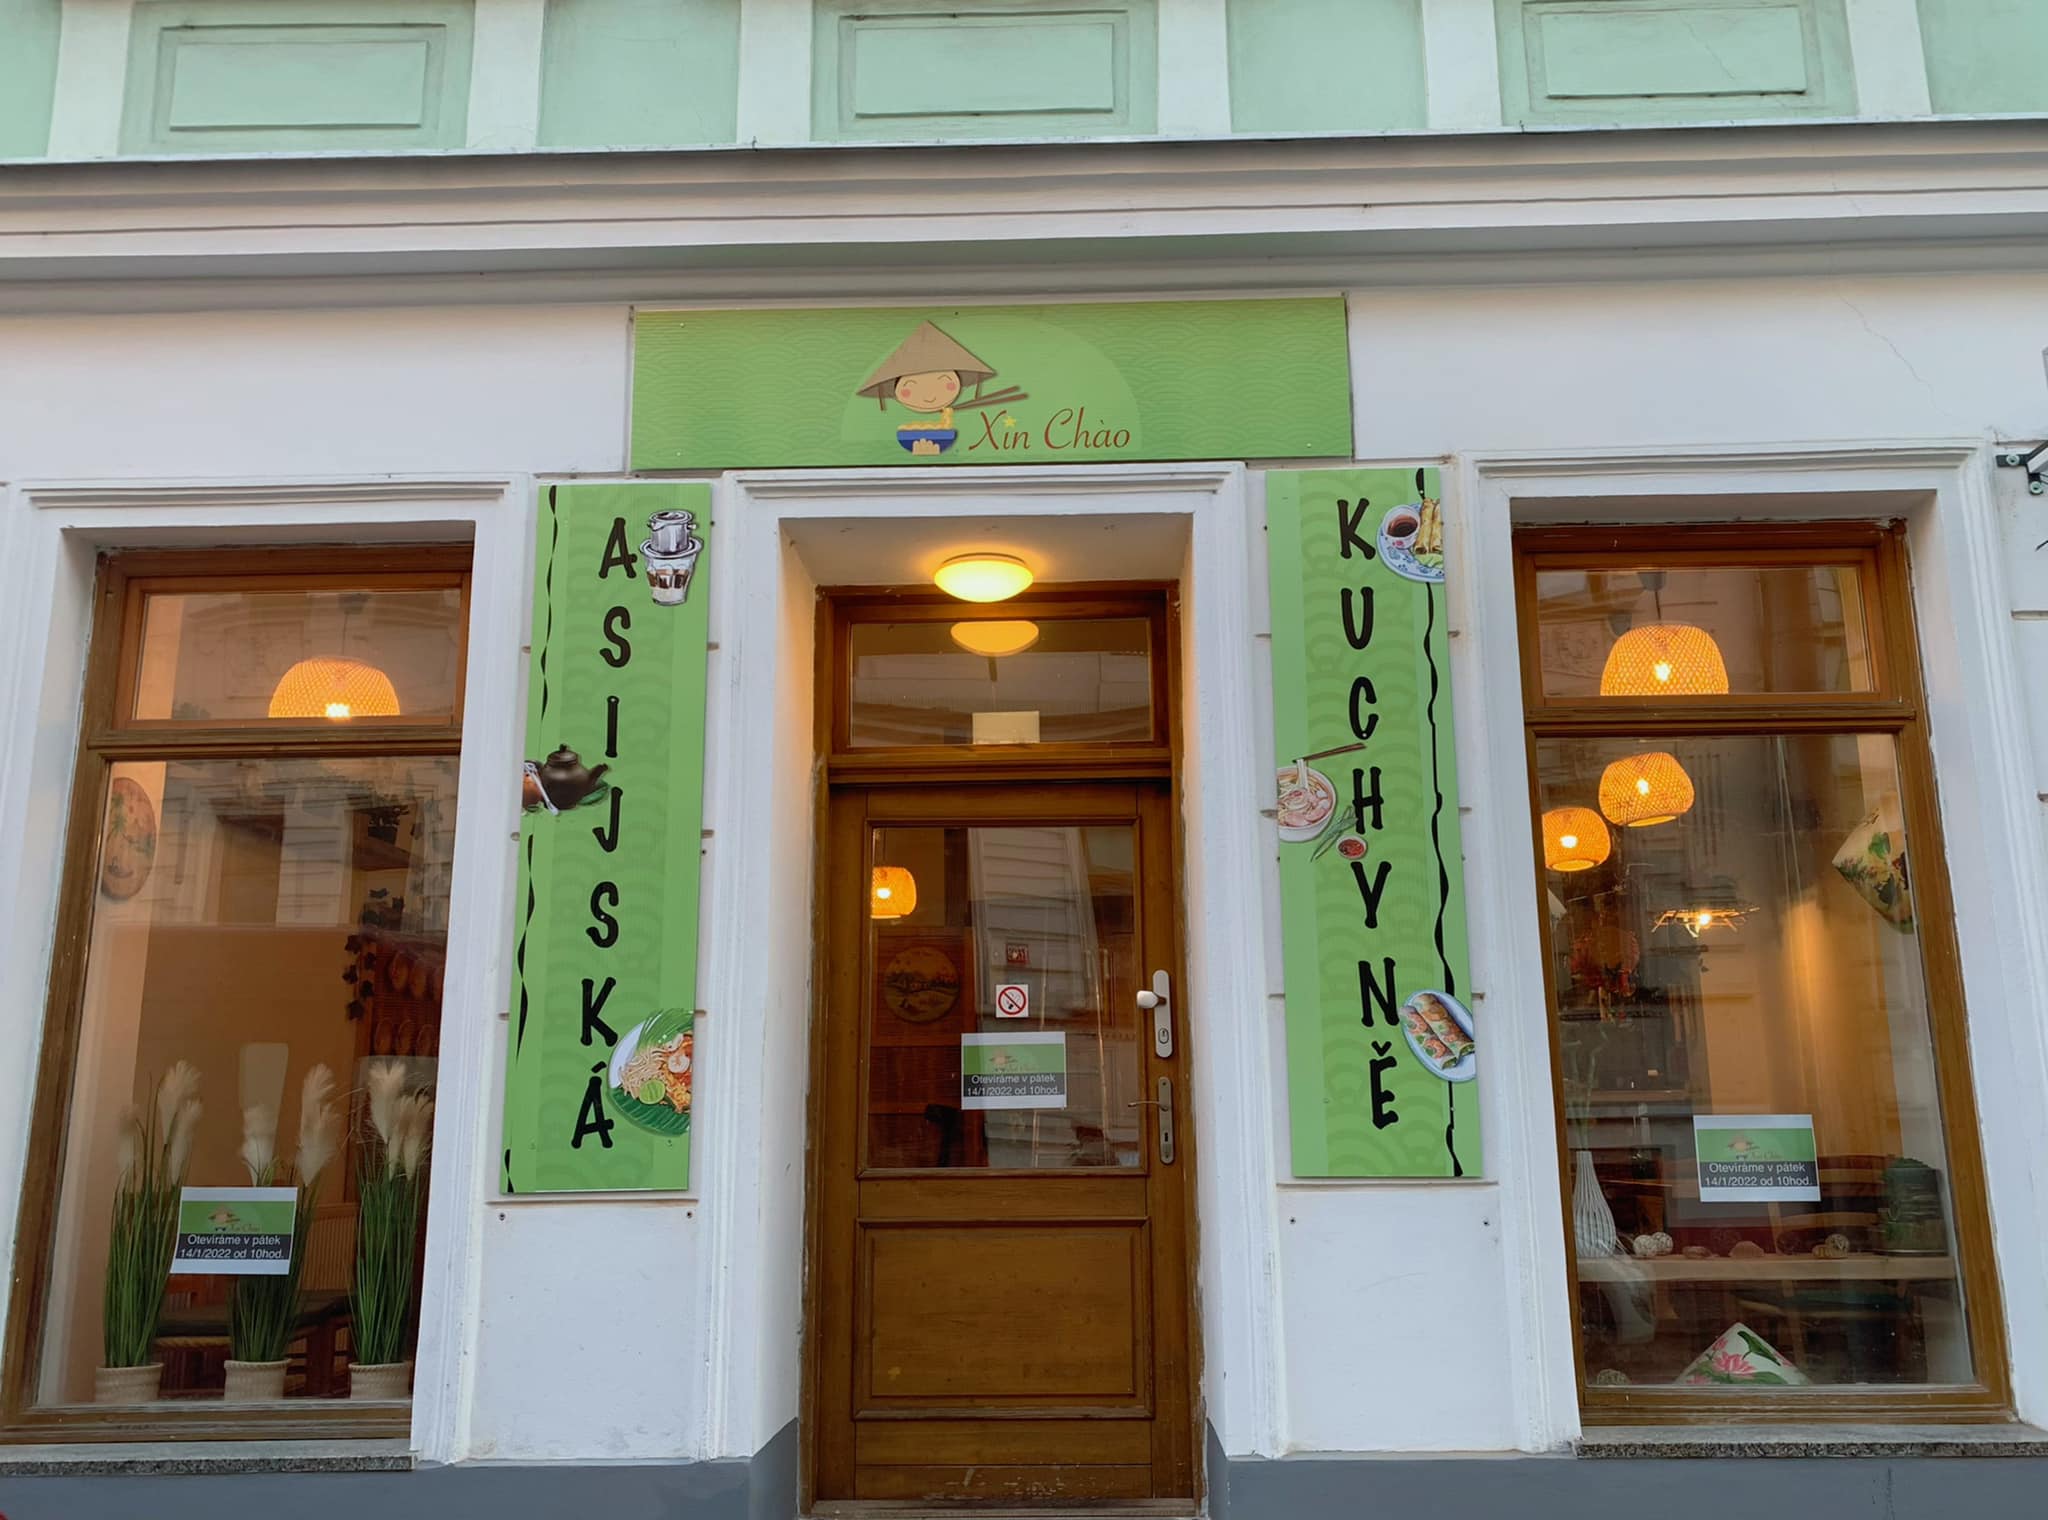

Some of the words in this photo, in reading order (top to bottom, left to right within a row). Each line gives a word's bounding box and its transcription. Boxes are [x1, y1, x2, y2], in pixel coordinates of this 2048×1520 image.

[968, 409, 1032, 451] Xin
[1043, 406, 1131, 450] Chào
[1336, 497, 1400, 1130] KUCHYNĚ
[571, 517, 638, 1149] ASIJSKÁ
[967, 1086, 1012, 1096] 14/1/2022
[1014, 1086, 1027, 1095] od
[1030, 1086, 1061, 1095] 10hod.
[1776, 1162, 1806, 1174] pátek
[1704, 1176, 1758, 1186] 14/1/2022
[1760, 1176, 1774, 1186] od
[1777, 1175, 1813, 1186] 10hod.
[187, 1234, 241, 1245] Otevíráme
[252, 1234, 281, 1247] pátek
[180, 1248, 231, 1258] 14/1/2022
[233, 1249, 247, 1259] od
[250, 1249, 284, 1259] 10hod.
